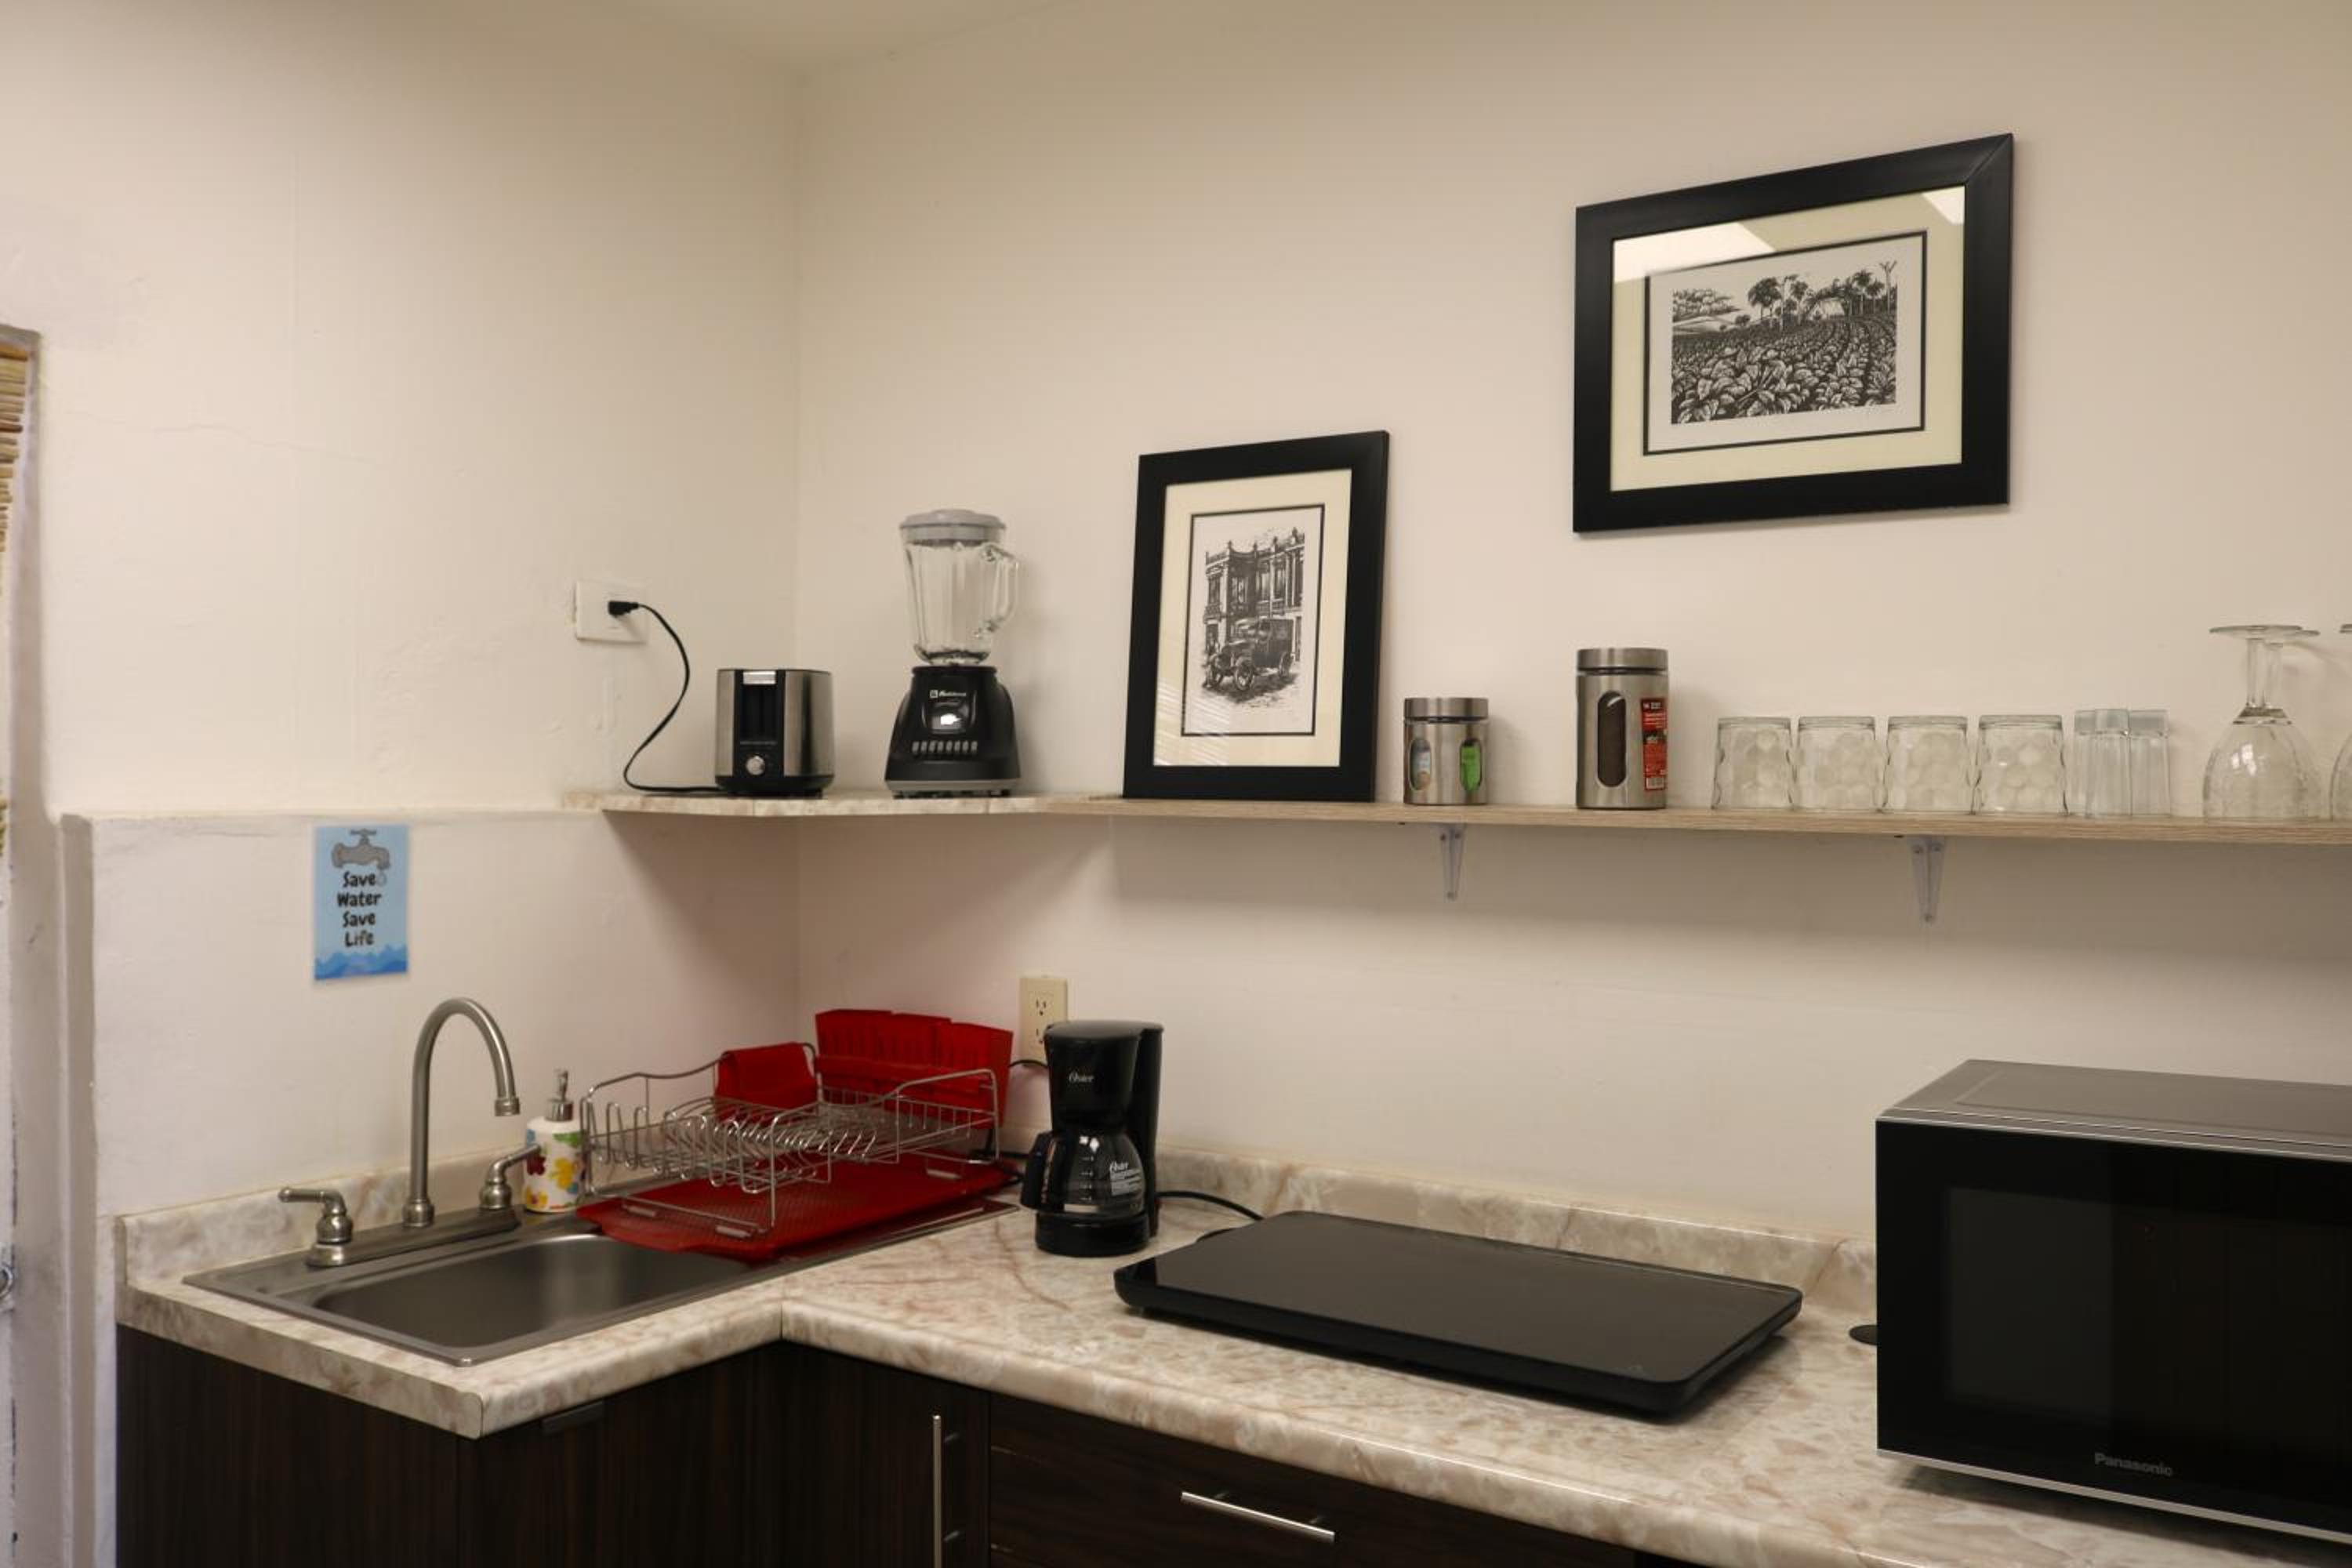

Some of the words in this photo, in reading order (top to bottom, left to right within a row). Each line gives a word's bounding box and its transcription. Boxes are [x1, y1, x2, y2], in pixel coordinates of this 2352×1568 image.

[343, 870, 376, 887] Save
[336, 891, 382, 907] Water
[342, 909, 376, 927] Save
[344, 929, 375, 947] Life
[2094, 1452, 2173, 1477] Panasonic
